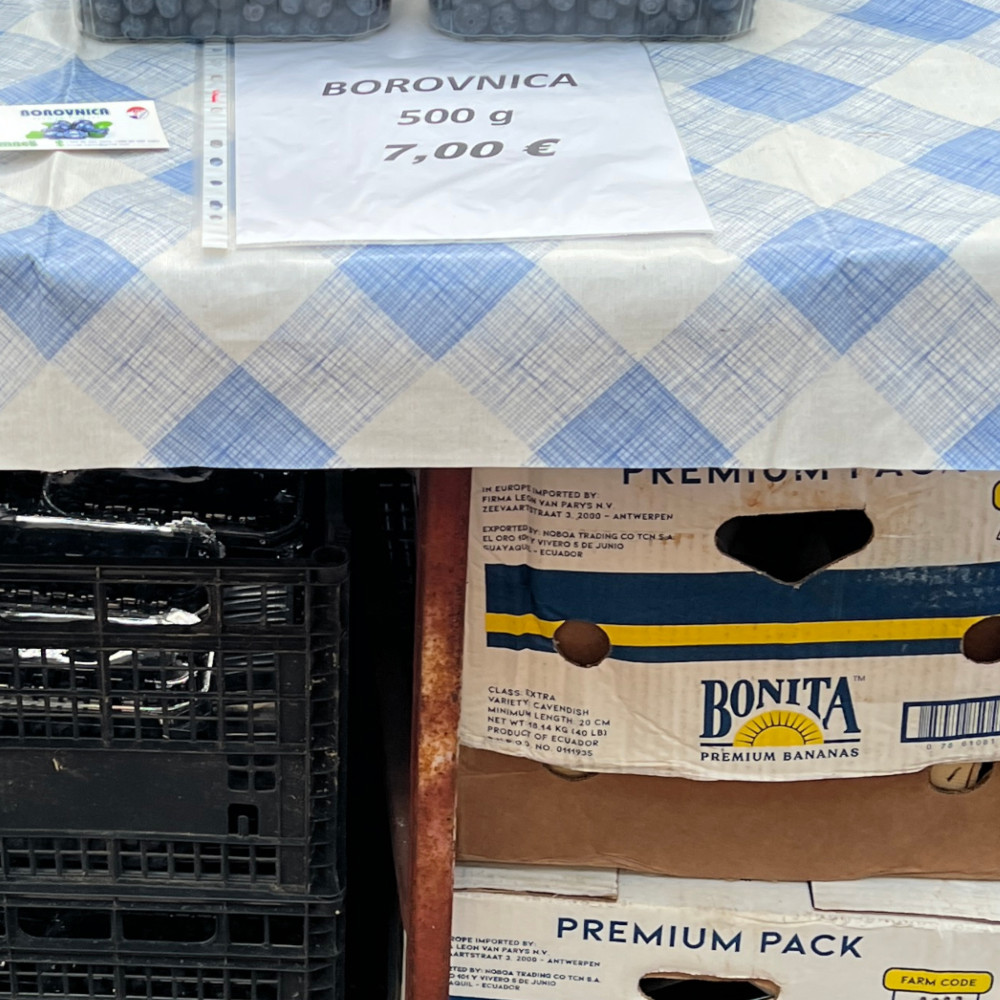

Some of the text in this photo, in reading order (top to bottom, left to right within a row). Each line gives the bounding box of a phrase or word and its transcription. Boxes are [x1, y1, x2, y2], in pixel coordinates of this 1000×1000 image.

[322, 73, 578, 96] BOROVNICA
[20, 108, 110, 116] BOROVNICA
[397, 108, 513, 126] 500 g
[384, 138, 561, 164] 7,00 €
[532, 488, 580, 498] IMPORTED
[543, 530, 575, 539] NOBOA
[538, 540, 570, 548] VIVERO
[526, 689, 556, 701] EXTRA
[488, 707, 531, 717] MINIMUM
[534, 702, 589, 716] CAVENDISH
[699, 676, 861, 738] BONITA
[488, 716, 506, 725] NET
[488, 726, 531, 737] PRODUCT
[551, 735, 599, 747] ECUADOR
[701, 748, 860, 762] PREMIUM BANANAS
[476, 938, 520, 946] IMPORTED
[557, 917, 864, 959] PREMIUM PACK
[547, 959, 600, 967] ANTWERPEN
[482, 982, 520, 990] ECUADOR
[901, 976, 936, 986] FARM
